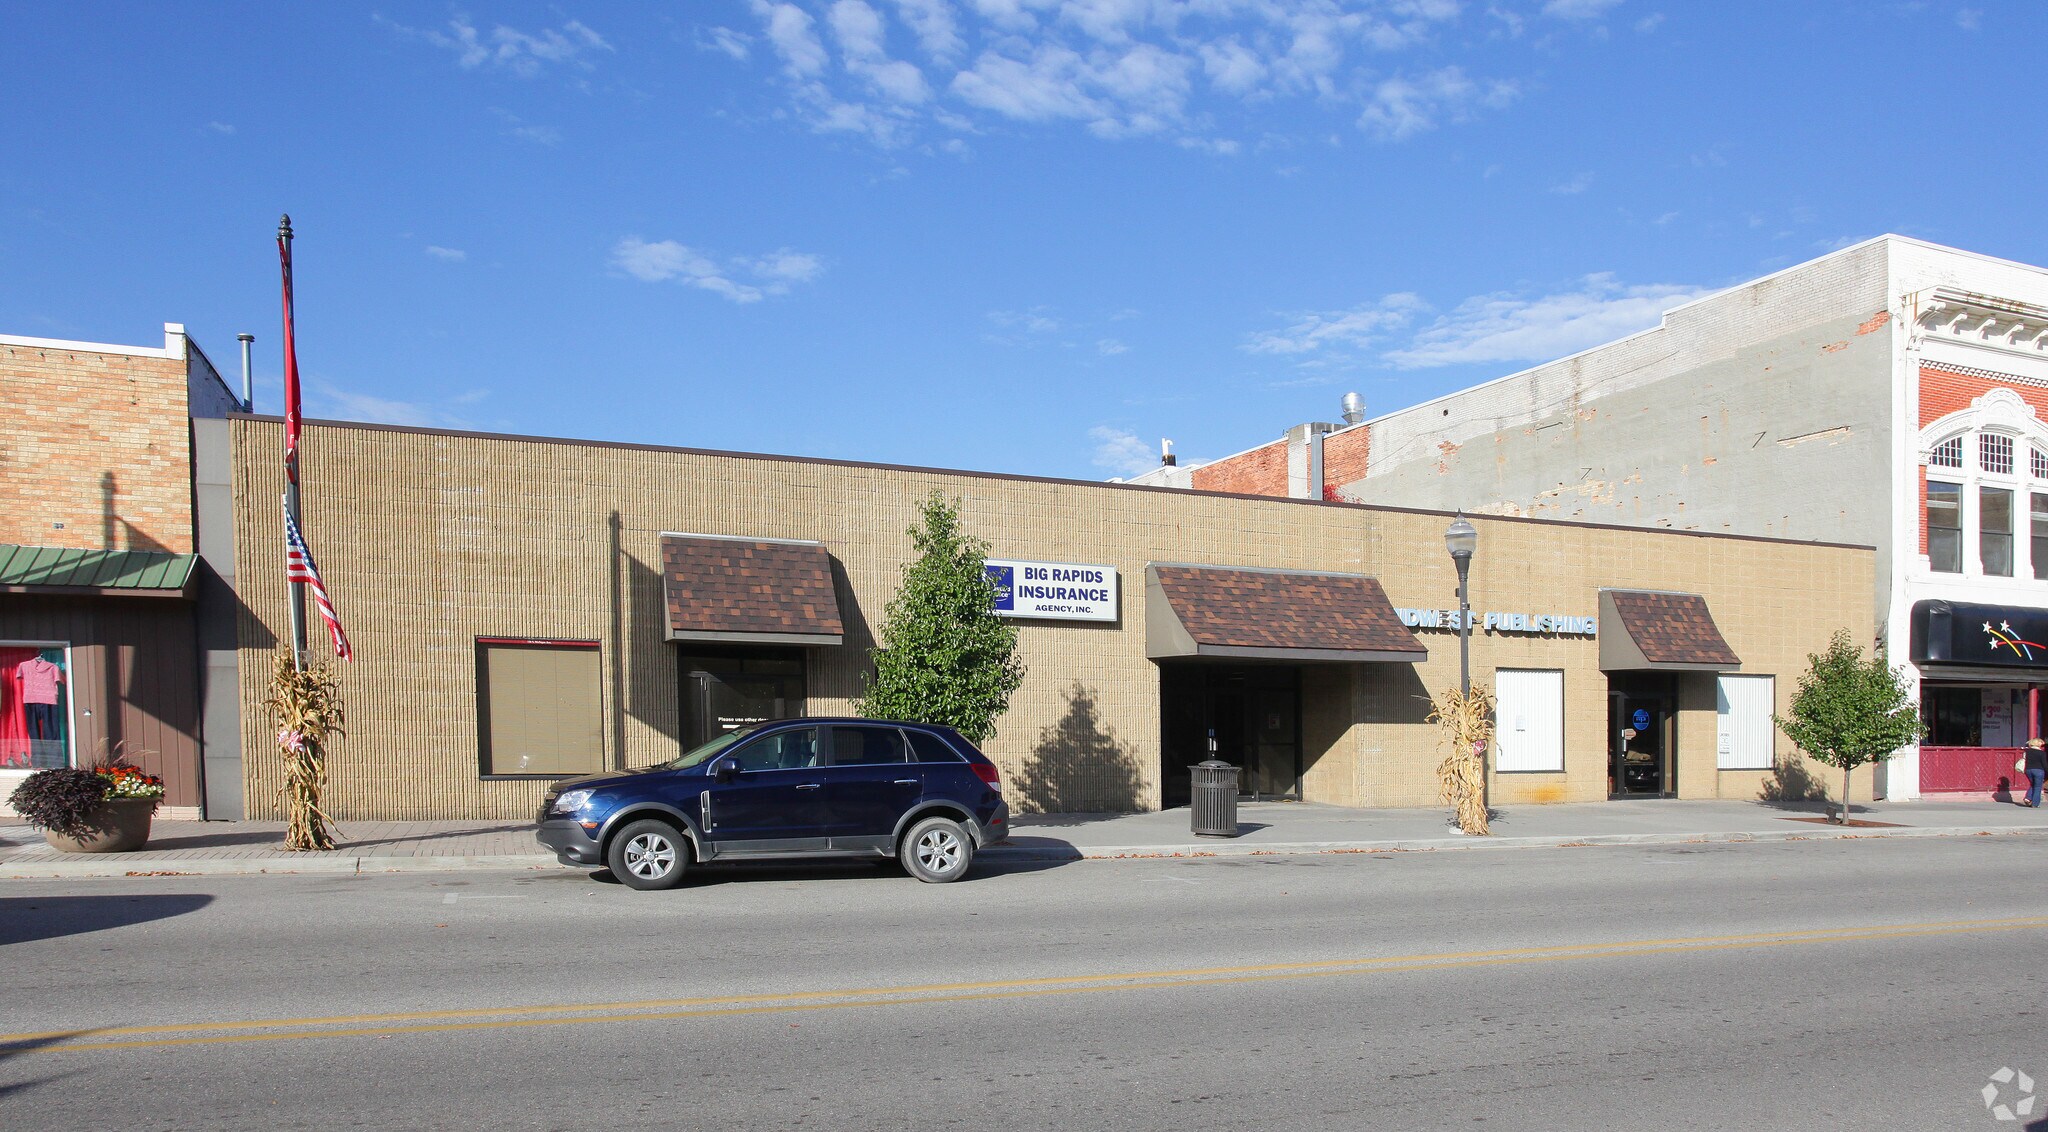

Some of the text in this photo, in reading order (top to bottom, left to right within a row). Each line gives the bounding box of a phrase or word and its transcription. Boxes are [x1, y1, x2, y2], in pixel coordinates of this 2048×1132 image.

[1025, 567, 1104, 584] BIG RAPIDS
[1018, 585, 1109, 602] INSURANCE
[1035, 604, 1094, 614] AGENCY, INC.
[1484, 612, 1597, 635] PUBLISHING
